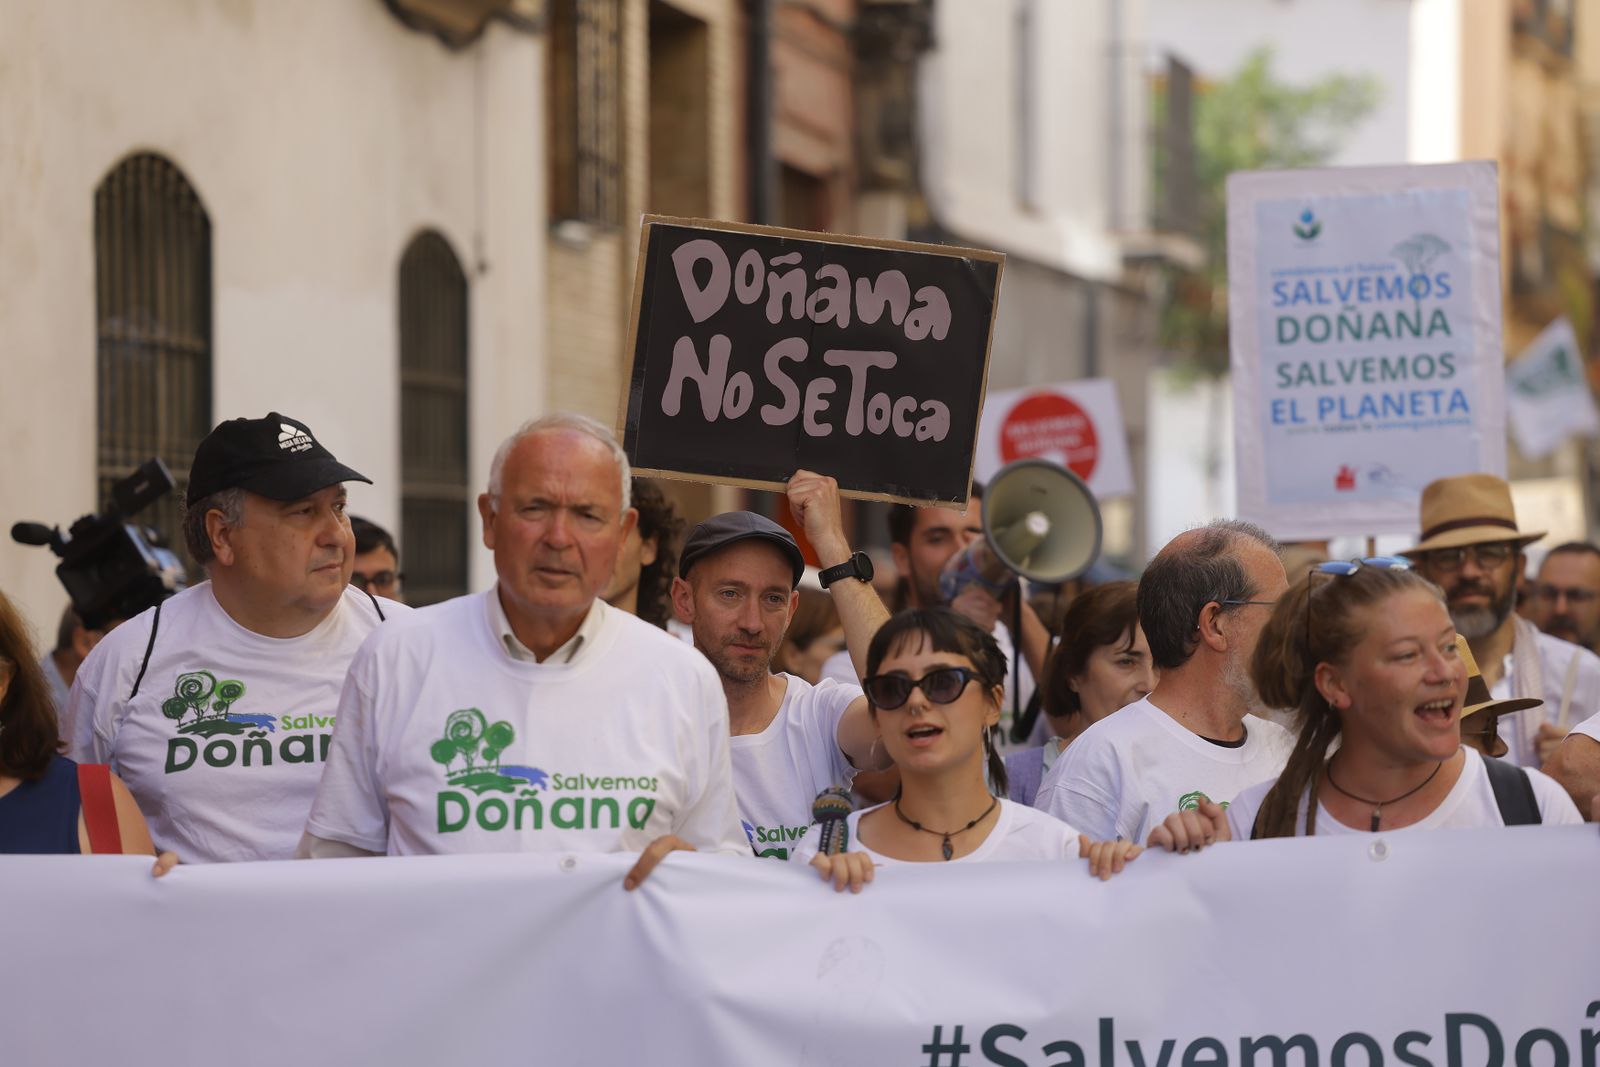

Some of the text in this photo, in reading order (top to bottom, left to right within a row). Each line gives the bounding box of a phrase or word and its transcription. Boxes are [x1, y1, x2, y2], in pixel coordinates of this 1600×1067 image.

[671, 239, 951, 340] Doñana
[1272, 272, 1453, 307] SALVEMOS
[1276, 304, 1452, 345] DOÑANA
[661, 334, 754, 422] No
[823, 349, 951, 442] Toca
[1276, 353, 1455, 388] SALVEMOS
[1271, 388, 1470, 425] EL PLANETA
[552, 773, 658, 792] Salvemos
[437, 788, 656, 834] Doñana
[756, 825, 817, 842] Salve
